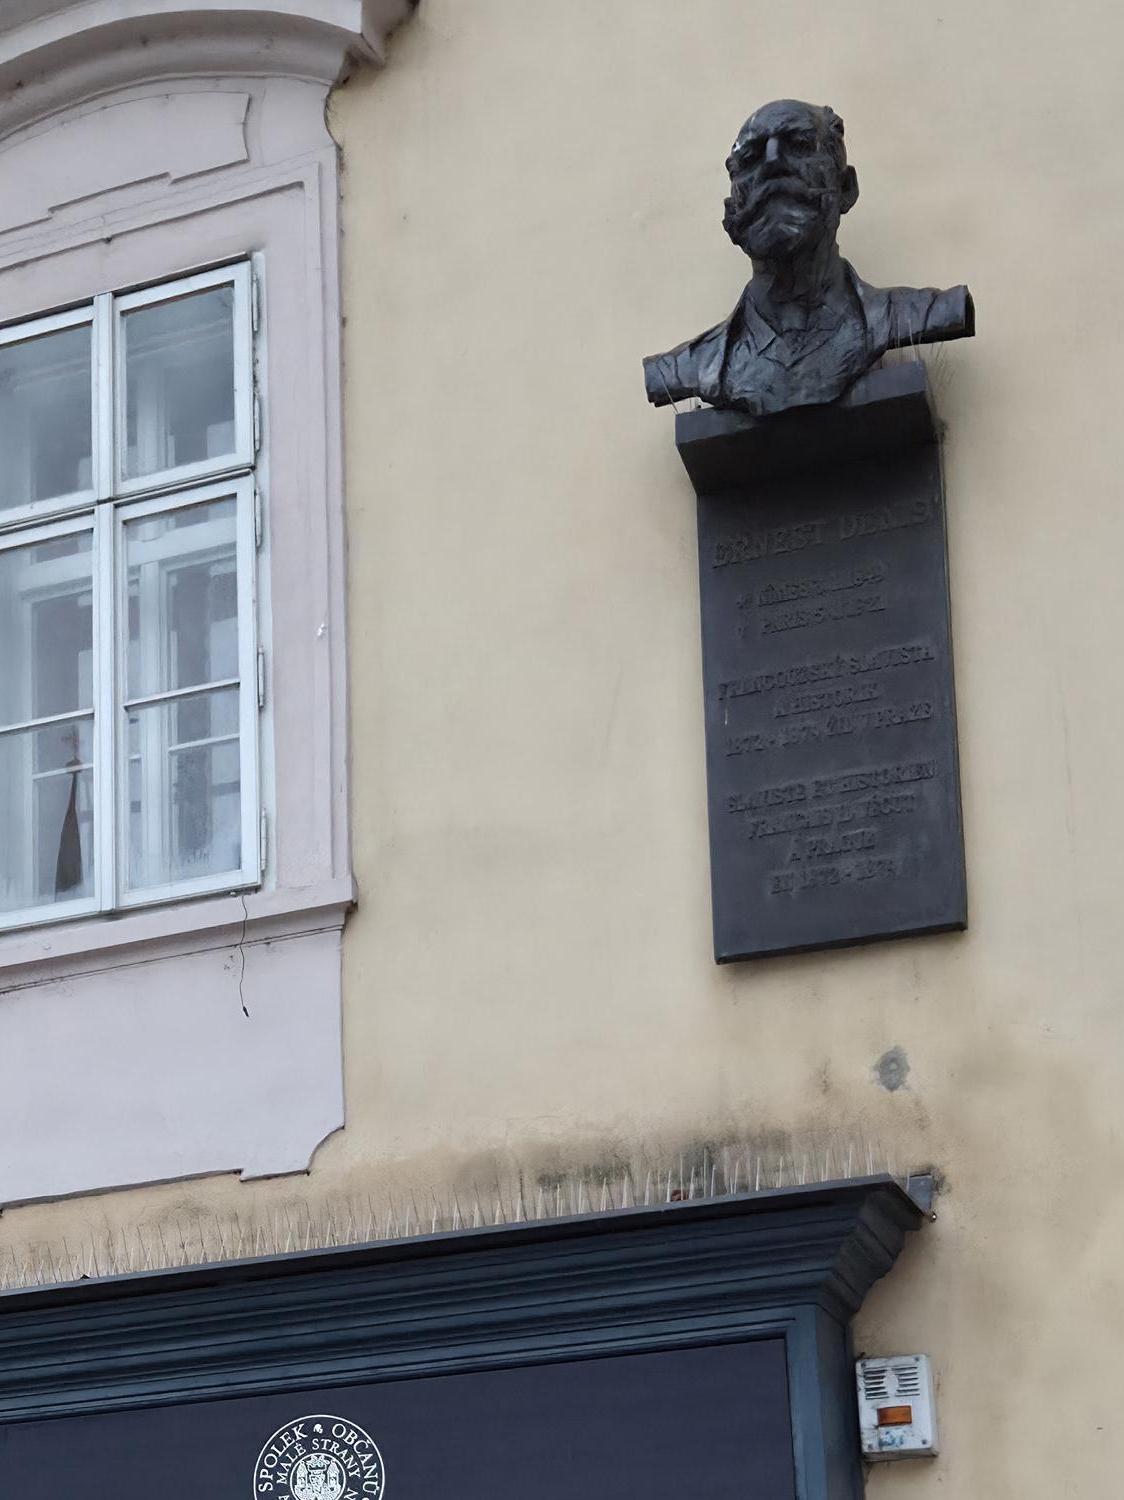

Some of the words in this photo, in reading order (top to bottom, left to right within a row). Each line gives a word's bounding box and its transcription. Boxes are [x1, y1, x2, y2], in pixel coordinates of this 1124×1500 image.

[258, 1423, 308, 1493] SPOLEK
[332, 1423, 381, 1495] OBČANŮ
[276, 1442, 307, 1485] MALÉ
[312, 1438, 361, 1479] STRANY
